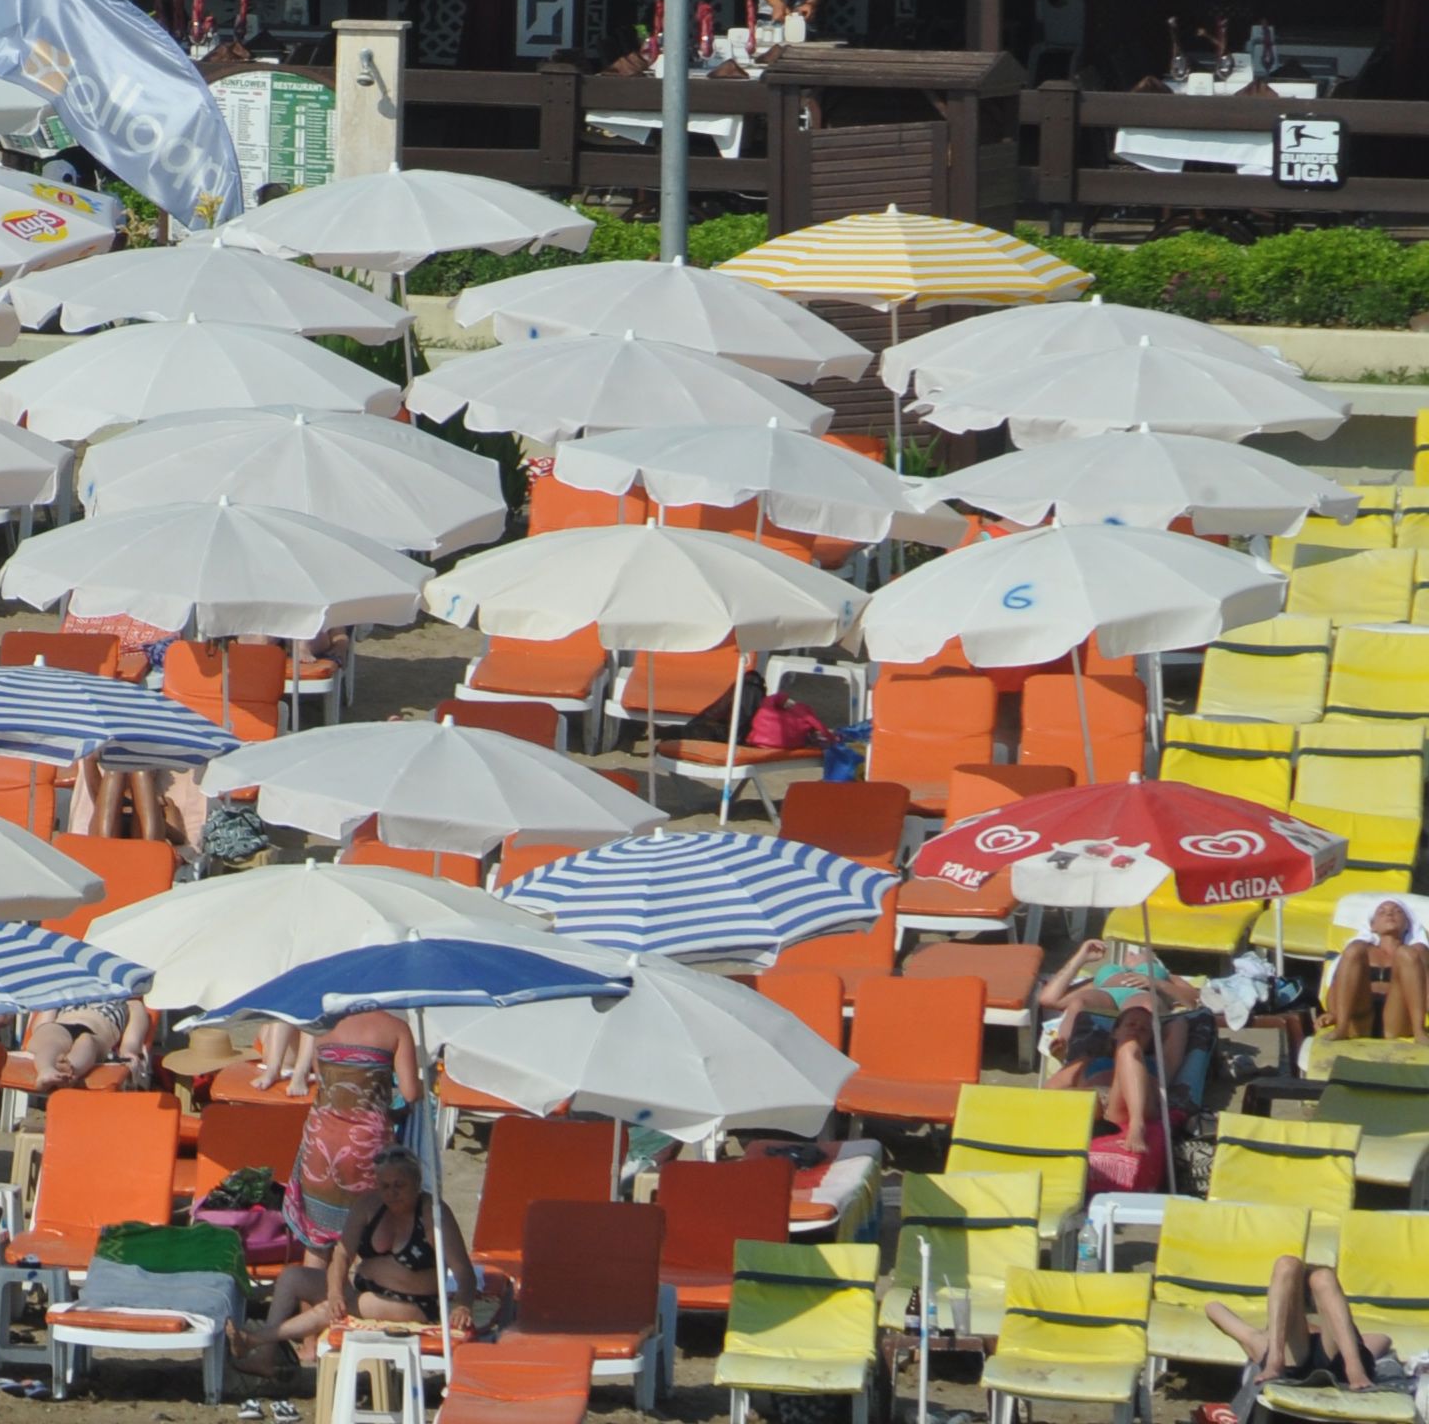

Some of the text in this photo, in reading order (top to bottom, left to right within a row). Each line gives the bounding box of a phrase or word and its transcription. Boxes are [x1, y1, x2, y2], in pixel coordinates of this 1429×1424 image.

[1280, 163, 1339, 183] LIGA
[8, 210, 58, 239] Lay's
[1002, 583, 1034, 611] 6
